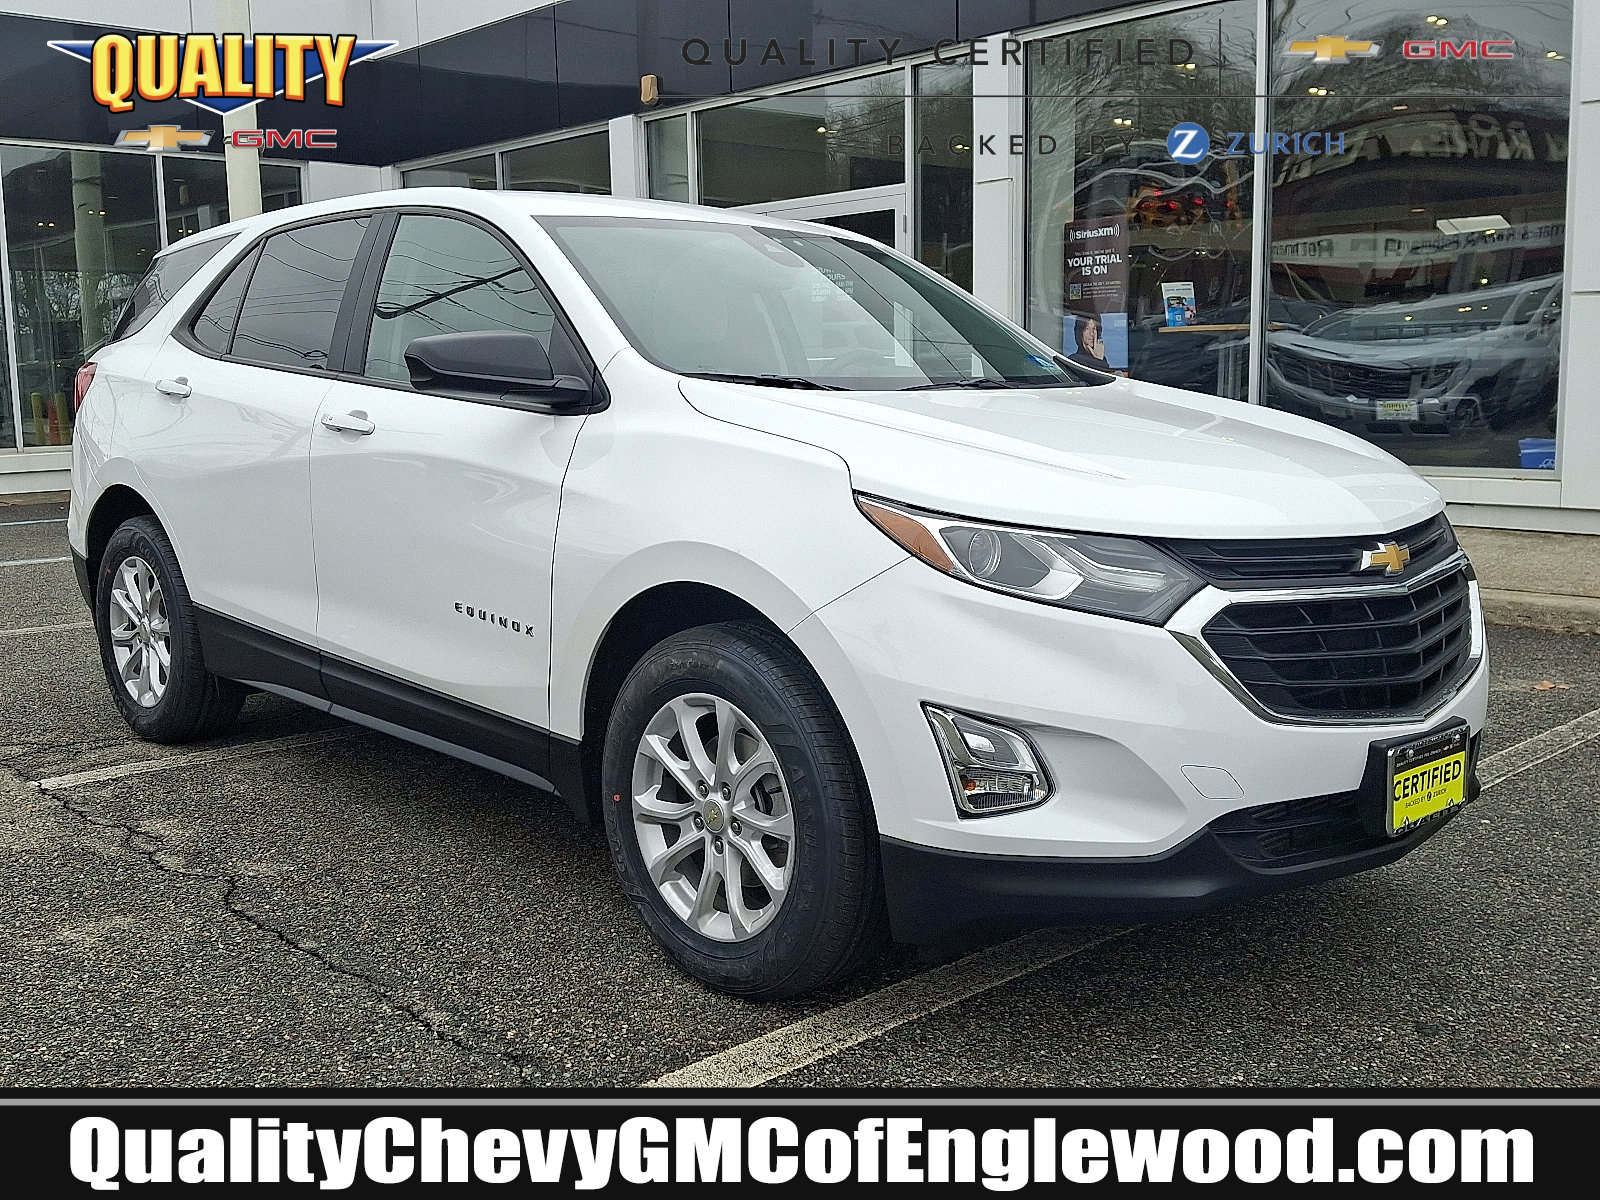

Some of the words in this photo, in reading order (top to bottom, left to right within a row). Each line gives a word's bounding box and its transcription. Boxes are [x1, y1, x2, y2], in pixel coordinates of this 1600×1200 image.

[1067, 257, 1093, 267] YOUR
[1094, 254, 1122, 265] TRIAL
[1081, 266, 1092, 277] IS
[1092, 264, 1108, 275] ON
[454, 602, 534, 638] EQUINOX
[1393, 760, 1462, 802] CERTIFIED
